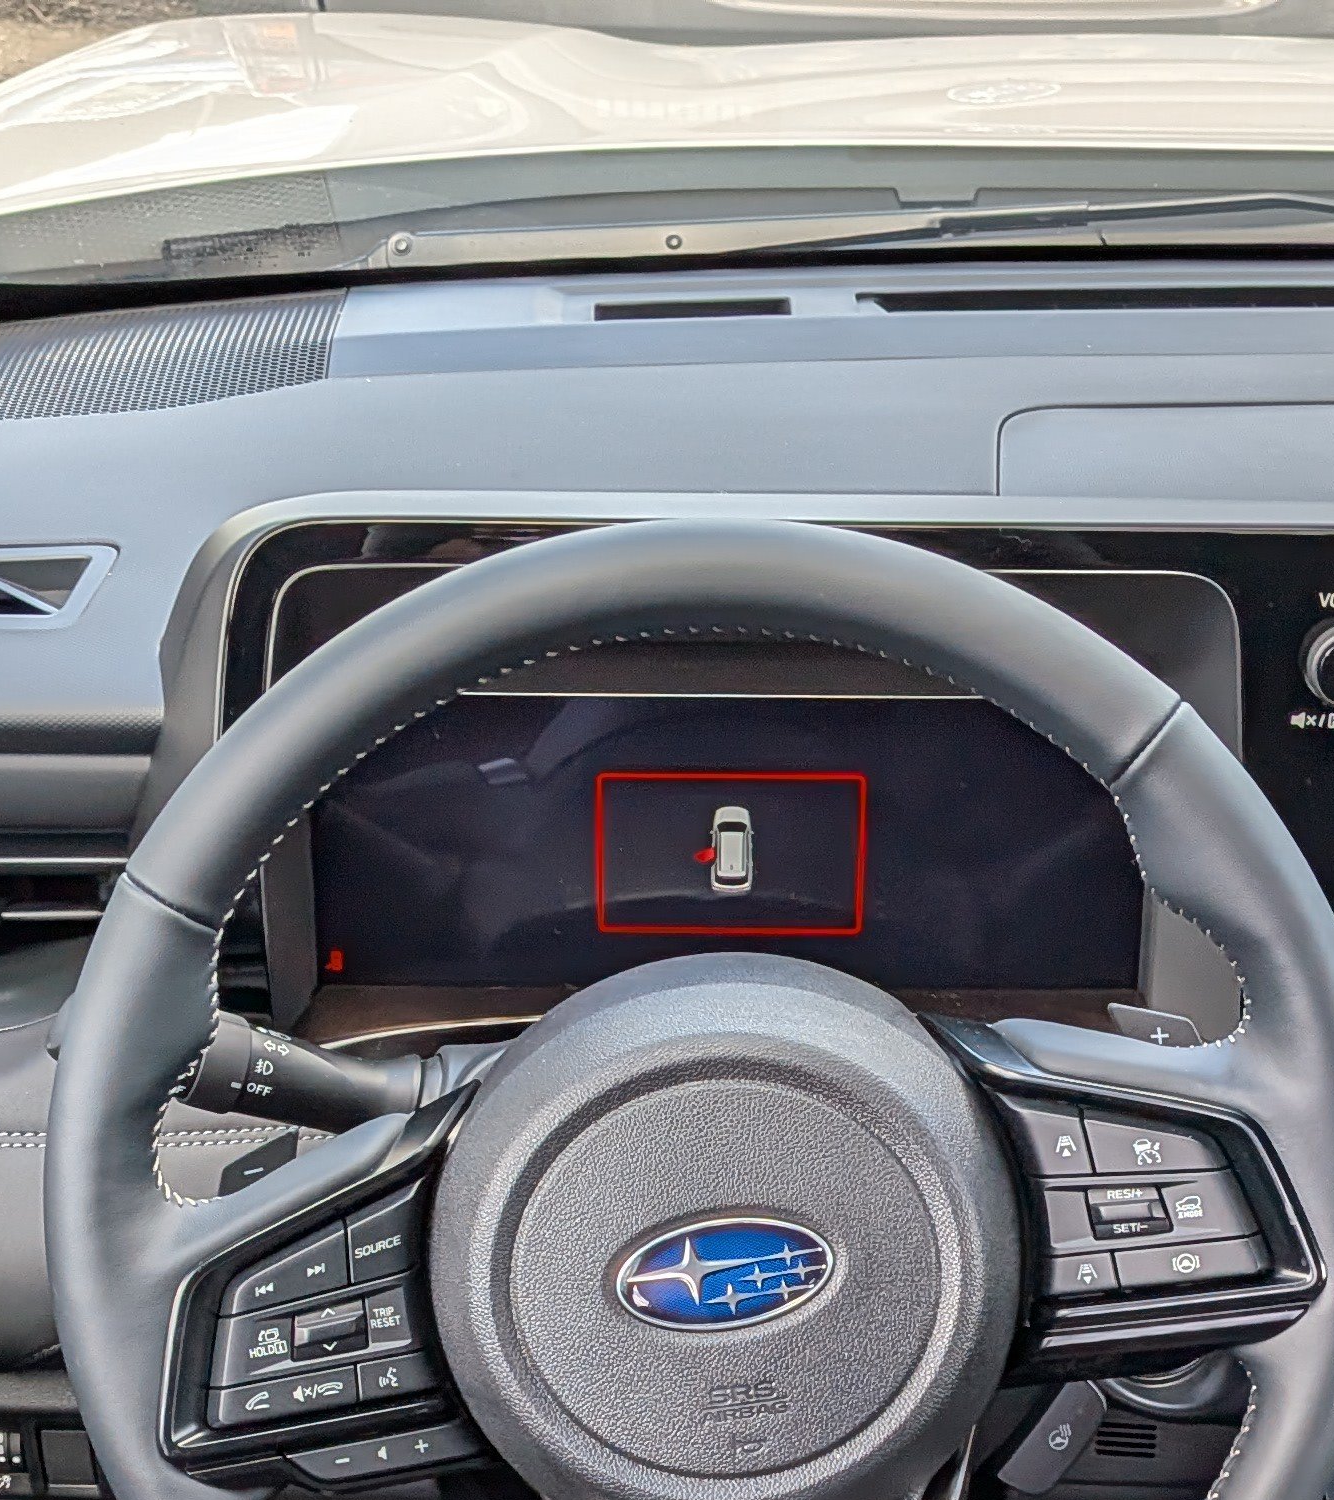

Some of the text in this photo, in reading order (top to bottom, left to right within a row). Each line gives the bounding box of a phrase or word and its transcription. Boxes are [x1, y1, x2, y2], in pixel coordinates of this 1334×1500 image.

[246, 1082, 274, 1097] OFF
[354, 1234, 402, 1259] SOURCE
[373, 1306, 395, 1319] TRIP
[370, 1315, 402, 1329] RESET
[248, 1344, 275, 1359] HOLD
[708, 1380, 775, 1405] SRS
[701, 1401, 788, 1424] AIRBAG
